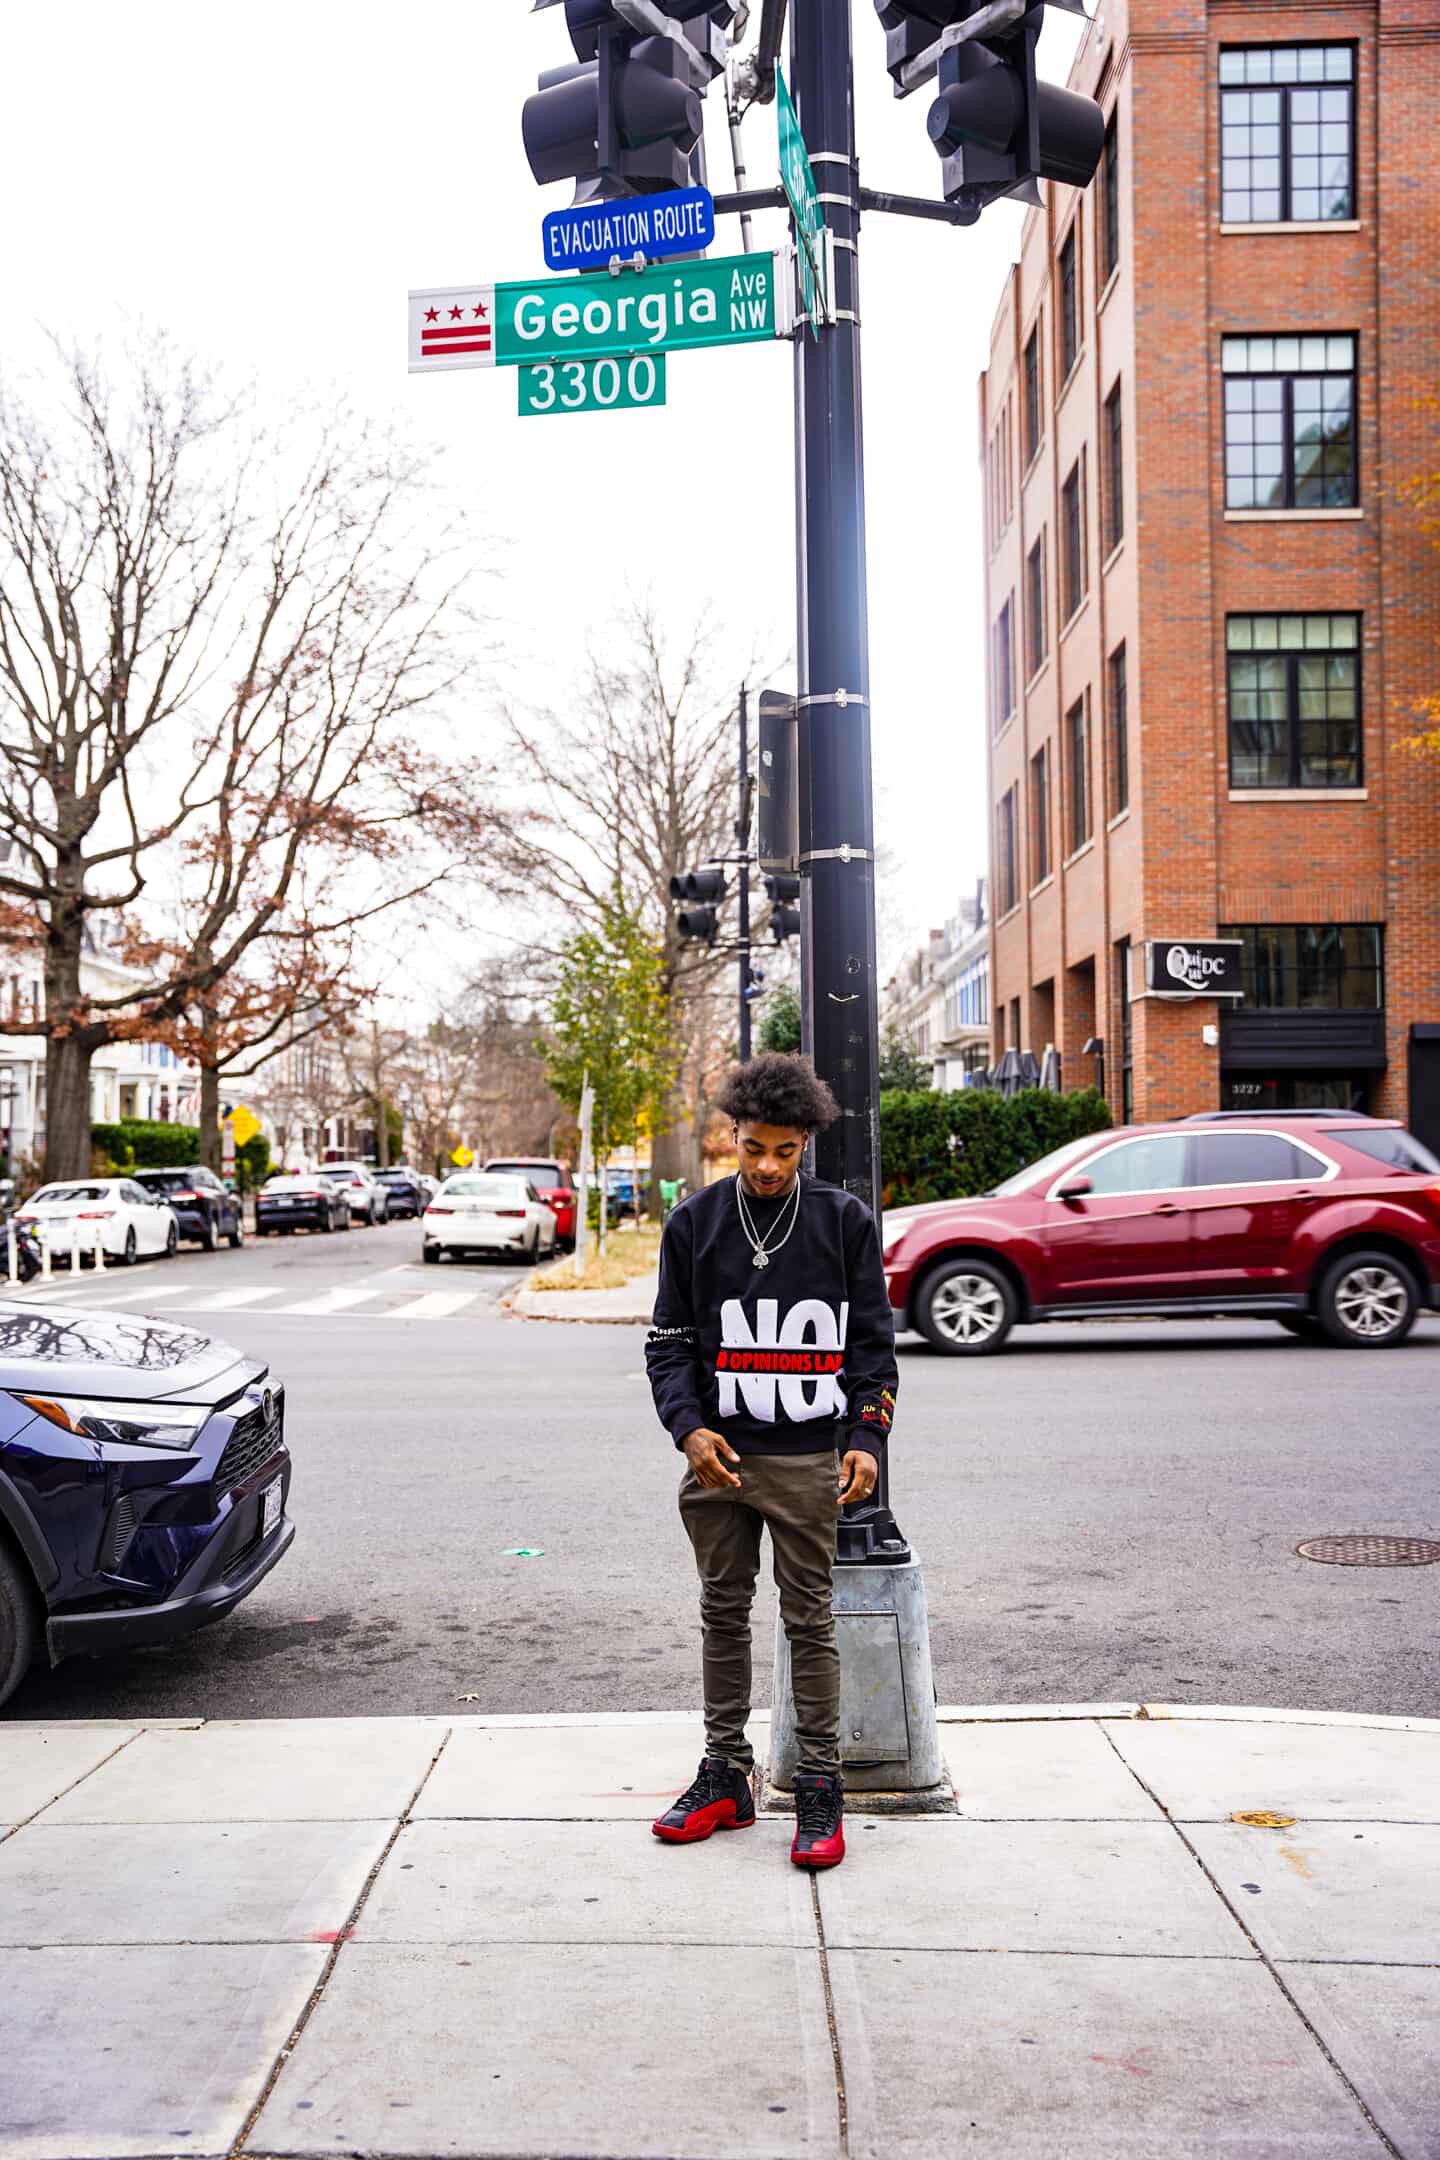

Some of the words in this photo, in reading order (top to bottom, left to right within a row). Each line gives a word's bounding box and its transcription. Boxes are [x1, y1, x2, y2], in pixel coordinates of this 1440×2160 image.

[550, 210, 650, 257] EVACUATION
[654, 201, 706, 239] ROUTE
[730, 268, 766, 298] Ave
[513, 279, 717, 344] Georgia
[730, 299, 767, 331] NW
[528, 355, 657, 410] 3300
[729, 1352, 813, 1373] OPINIONS
